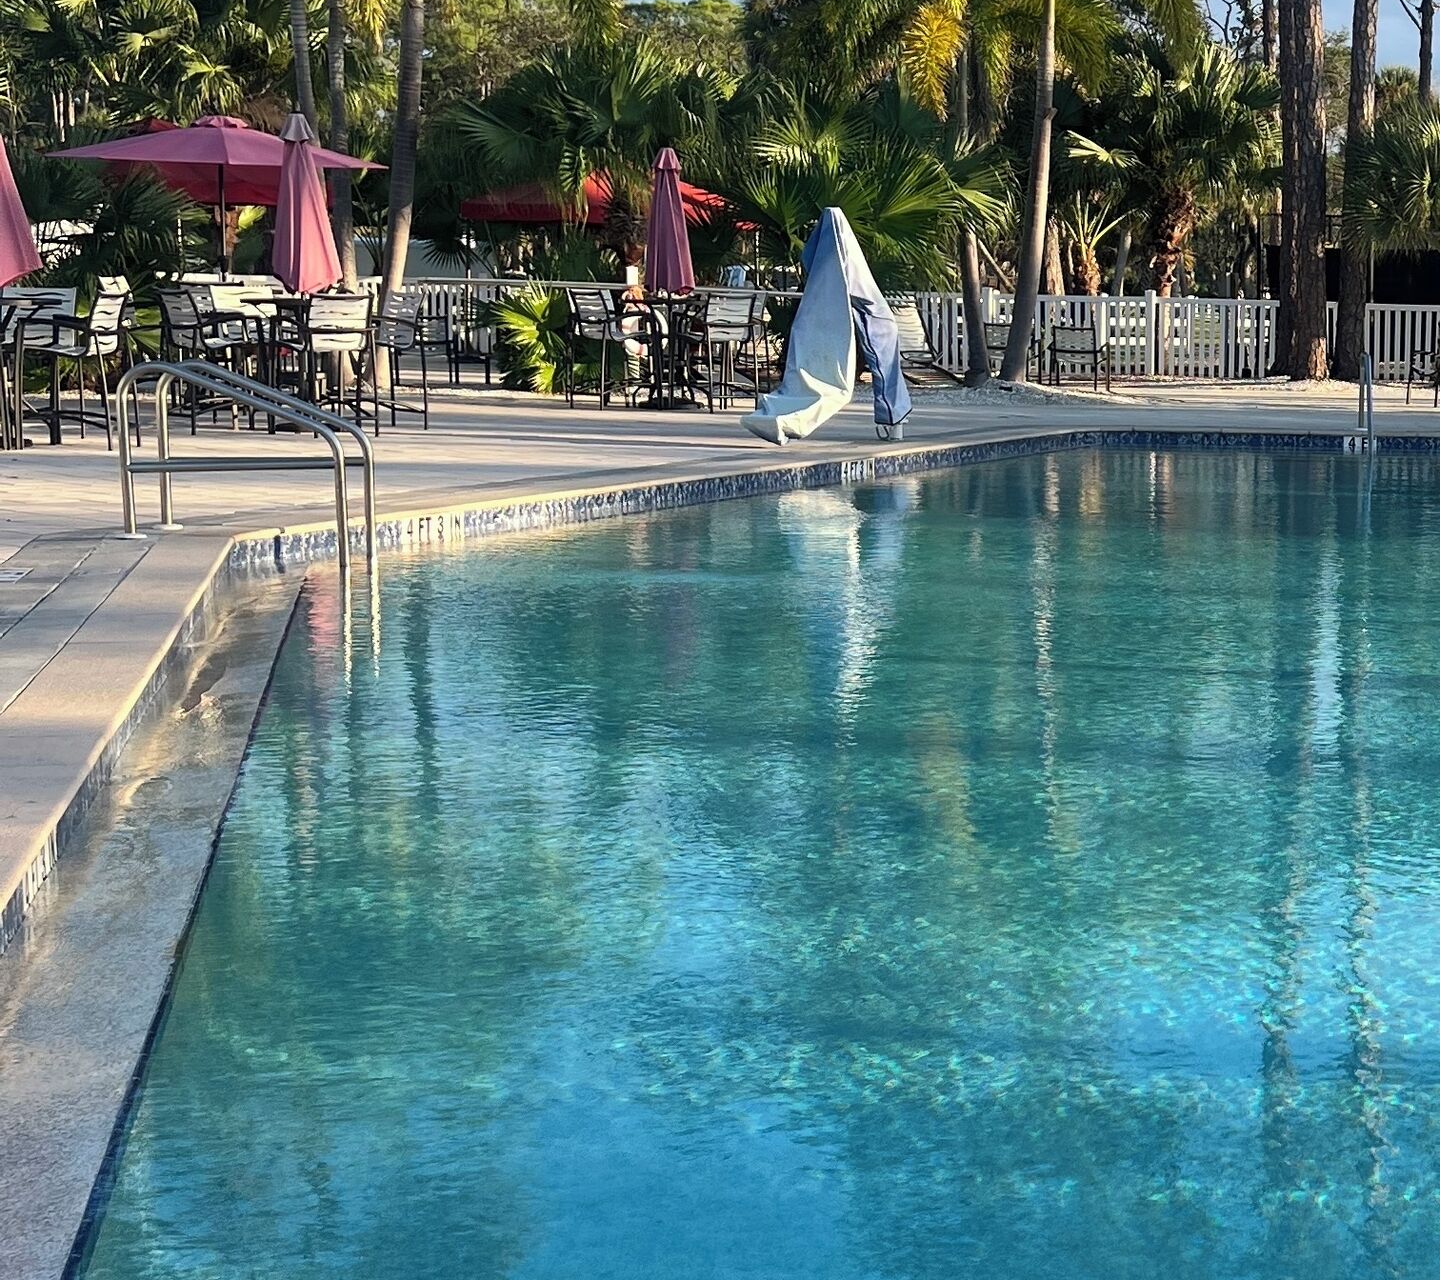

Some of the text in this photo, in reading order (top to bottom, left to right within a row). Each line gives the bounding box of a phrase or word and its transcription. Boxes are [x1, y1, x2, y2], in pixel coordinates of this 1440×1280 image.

[1348, 436, 1356, 451] 4
[407, 519, 413, 537] 4
[418, 517, 431, 539] FT
[438, 516, 444, 535] 3
